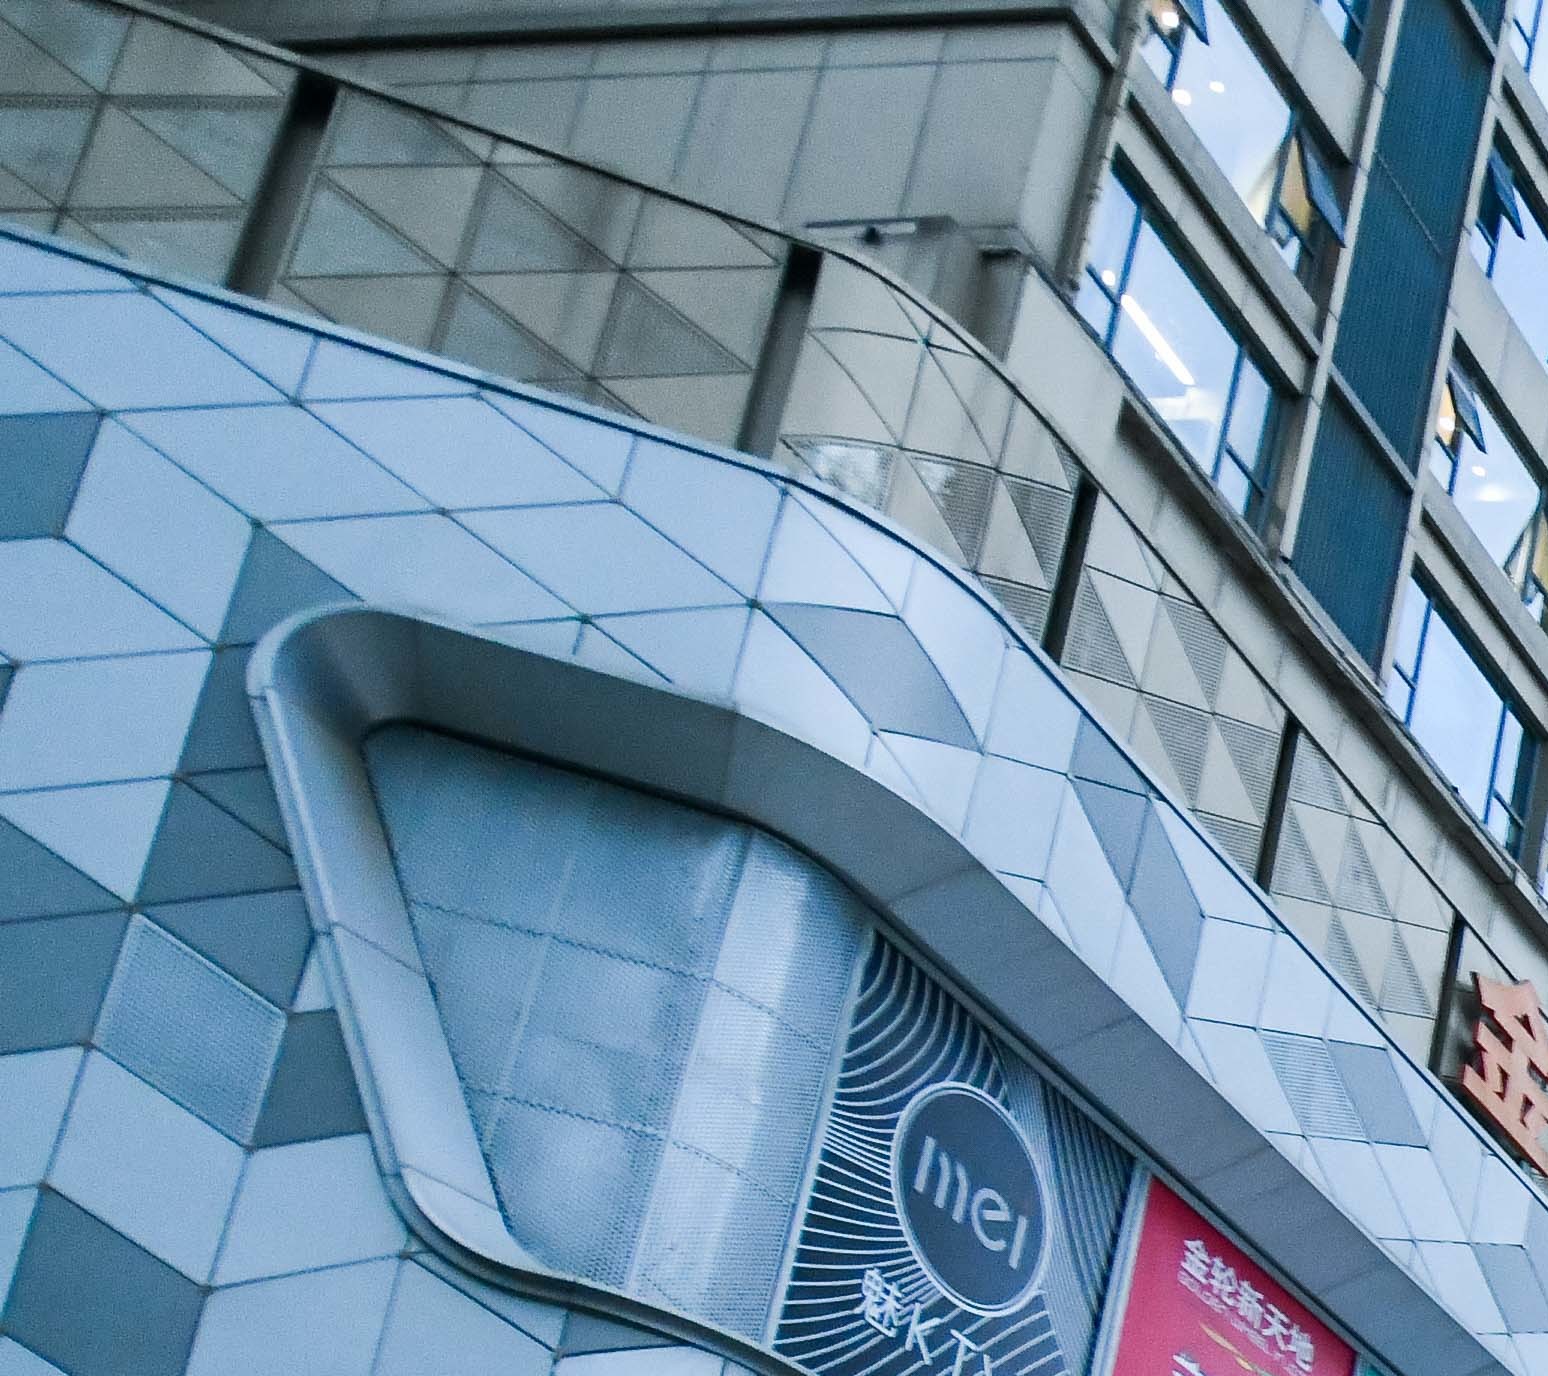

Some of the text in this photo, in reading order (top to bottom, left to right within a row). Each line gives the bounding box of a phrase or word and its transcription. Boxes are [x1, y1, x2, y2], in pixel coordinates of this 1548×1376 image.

[1179, 1239, 1315, 1373] 金轮新天地
